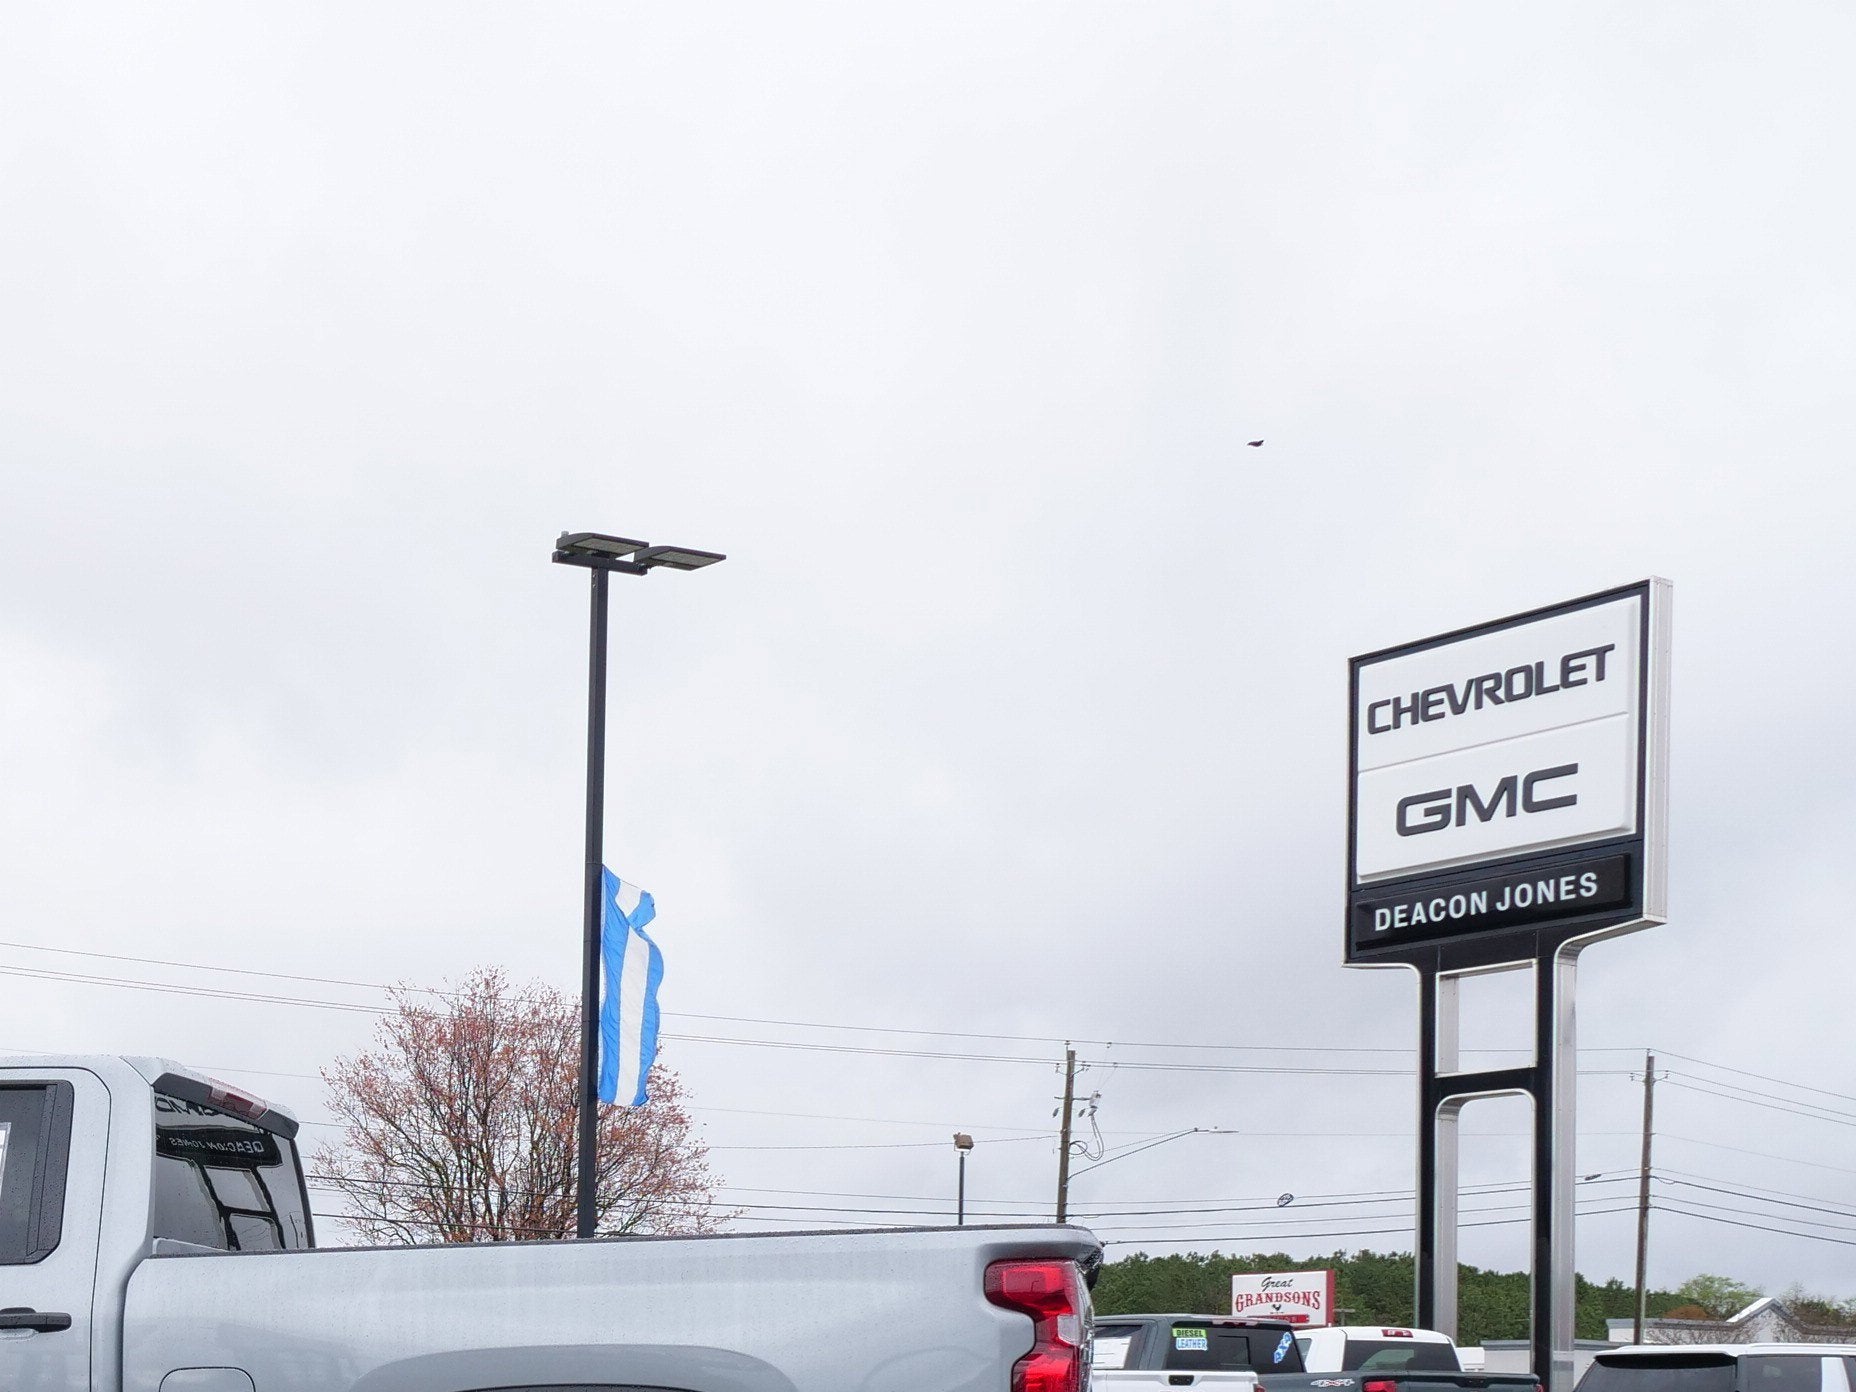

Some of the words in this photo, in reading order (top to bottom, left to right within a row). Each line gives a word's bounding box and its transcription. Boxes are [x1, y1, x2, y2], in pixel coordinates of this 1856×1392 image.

[1367, 643, 1615, 735] CHEVROLET
[1396, 762, 1579, 837] GMC
[1375, 891, 1487, 932] DEACON
[1496, 872, 1598, 912] JONES
[1261, 1276, 1294, 1292] Great
[1235, 1291, 1321, 1313] GRANDSONS
[1176, 1329, 1204, 1338] DIESEL
[1177, 1338, 1207, 1349] LEATHER
